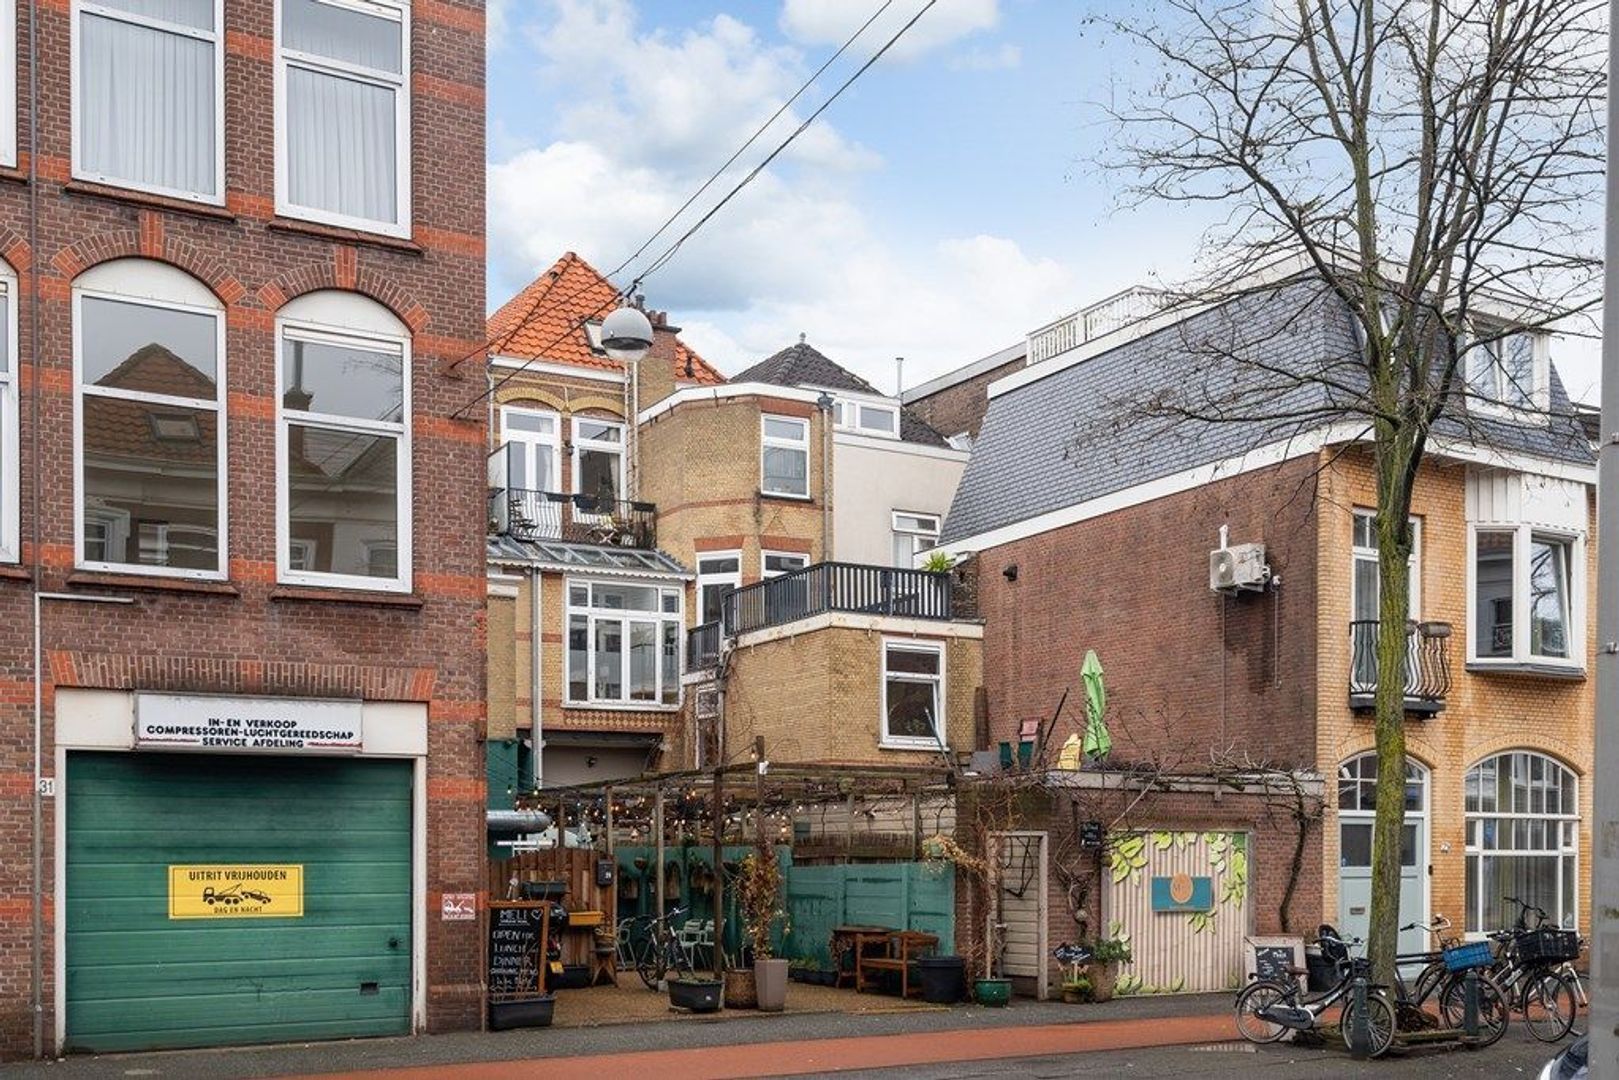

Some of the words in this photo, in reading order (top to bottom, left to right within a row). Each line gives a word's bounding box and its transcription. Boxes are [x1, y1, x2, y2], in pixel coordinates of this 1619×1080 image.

[245, 719, 298, 729] VERKOOP
[202, 737, 248, 747] SERVICE
[252, 739, 304, 749] AFDELING
[40, 780, 53, 793] 31
[188, 871, 222, 880] UITRIT
[224, 870, 287, 880] VRIJHOUDEN
[491, 930, 521, 941] OPEN
